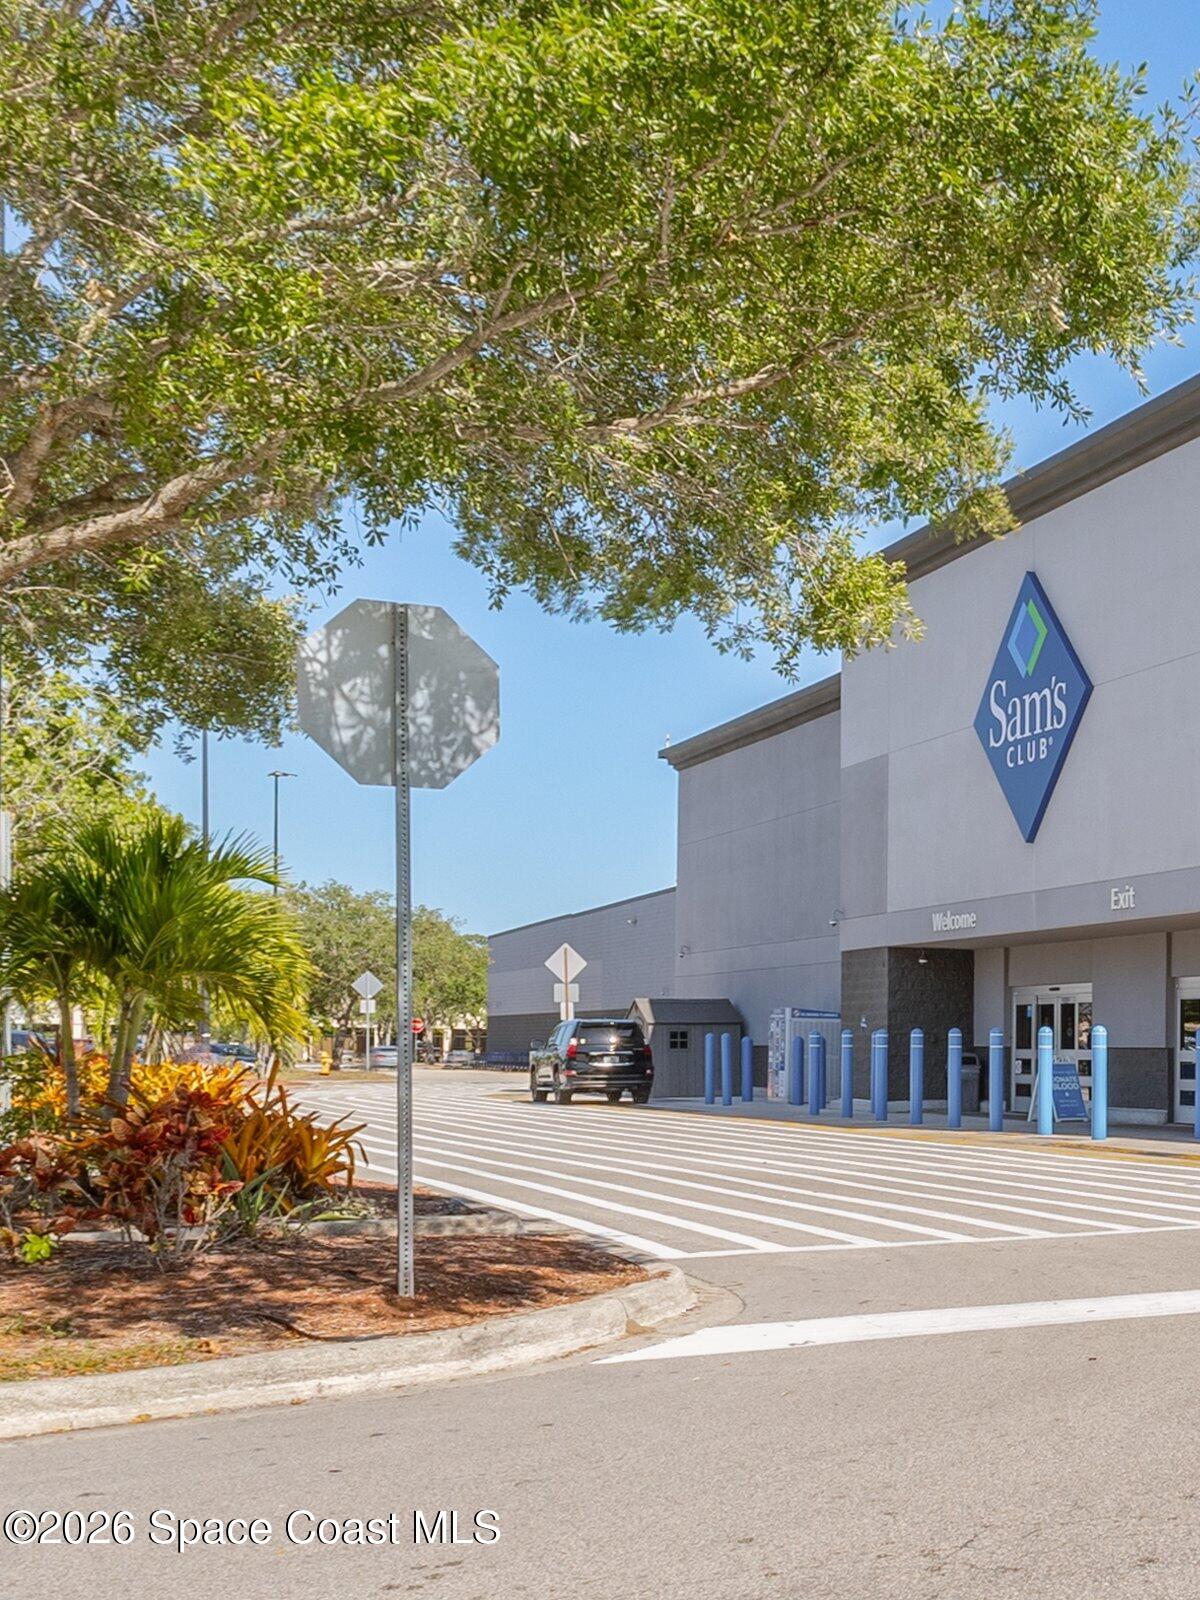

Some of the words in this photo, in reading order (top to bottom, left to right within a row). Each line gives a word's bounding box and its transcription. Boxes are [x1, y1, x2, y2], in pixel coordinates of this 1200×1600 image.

[989, 675, 1067, 748] Sam's
[1110, 884, 1136, 909] Exit
[931, 910, 977, 931] Welcome
